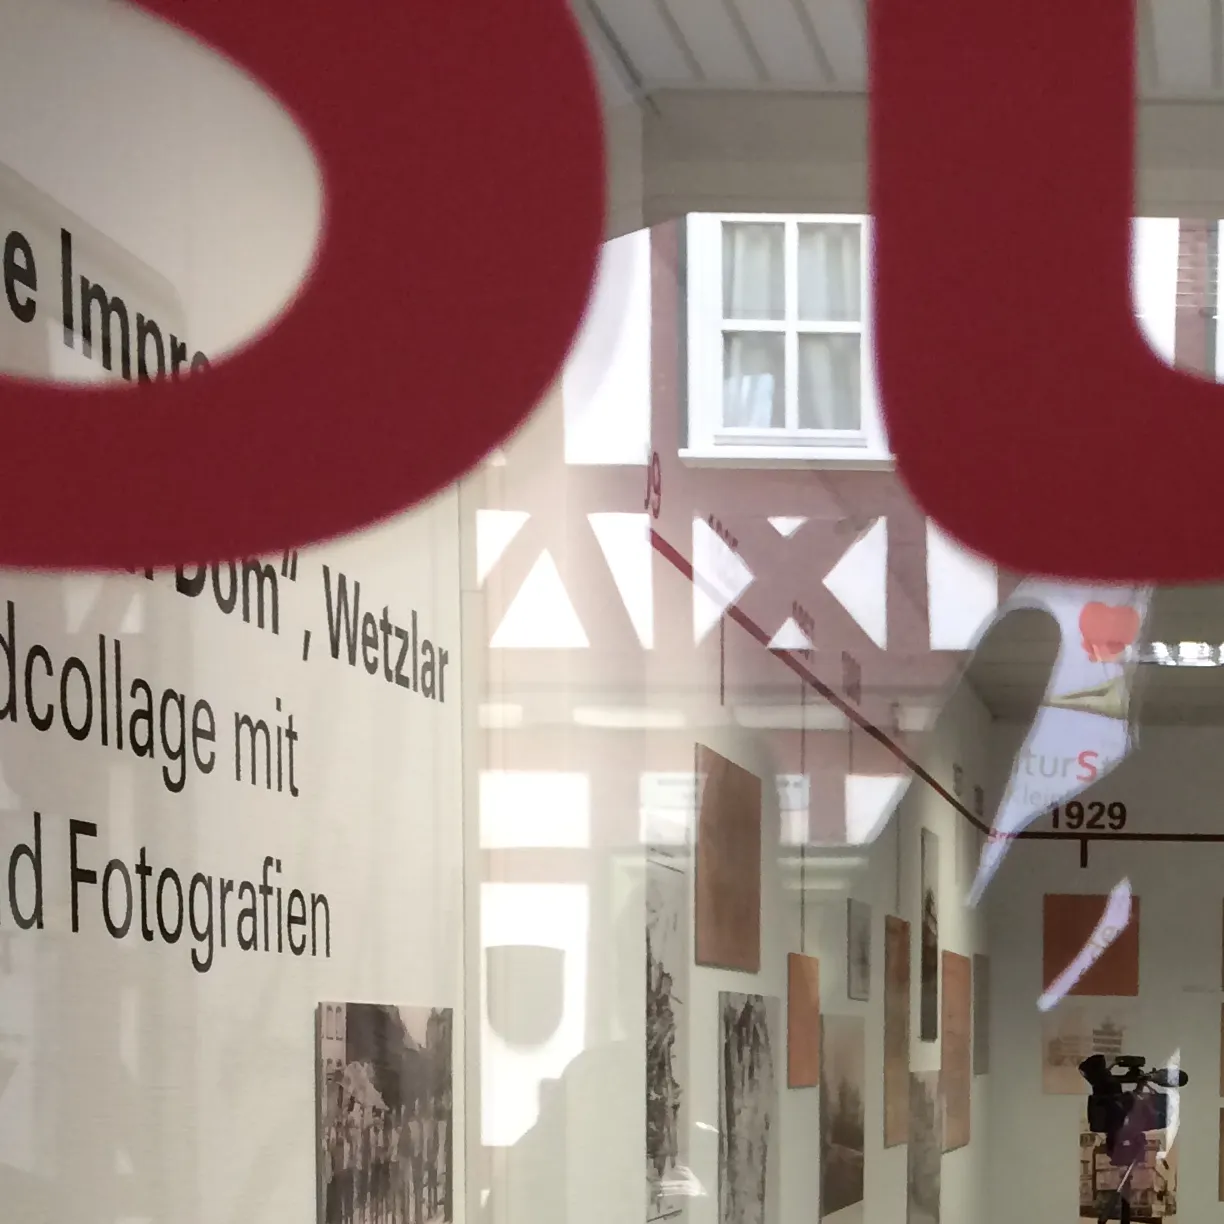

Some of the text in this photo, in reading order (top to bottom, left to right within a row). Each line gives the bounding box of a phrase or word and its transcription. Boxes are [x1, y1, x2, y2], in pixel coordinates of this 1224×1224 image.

[60, 227, 211, 387] Impr
[322, 563, 449, 703] Wetzlar
[234, 696, 299, 798] mit
[1050, 801, 1127, 831] 1929
[8, 811, 331, 974] d Fotografien
